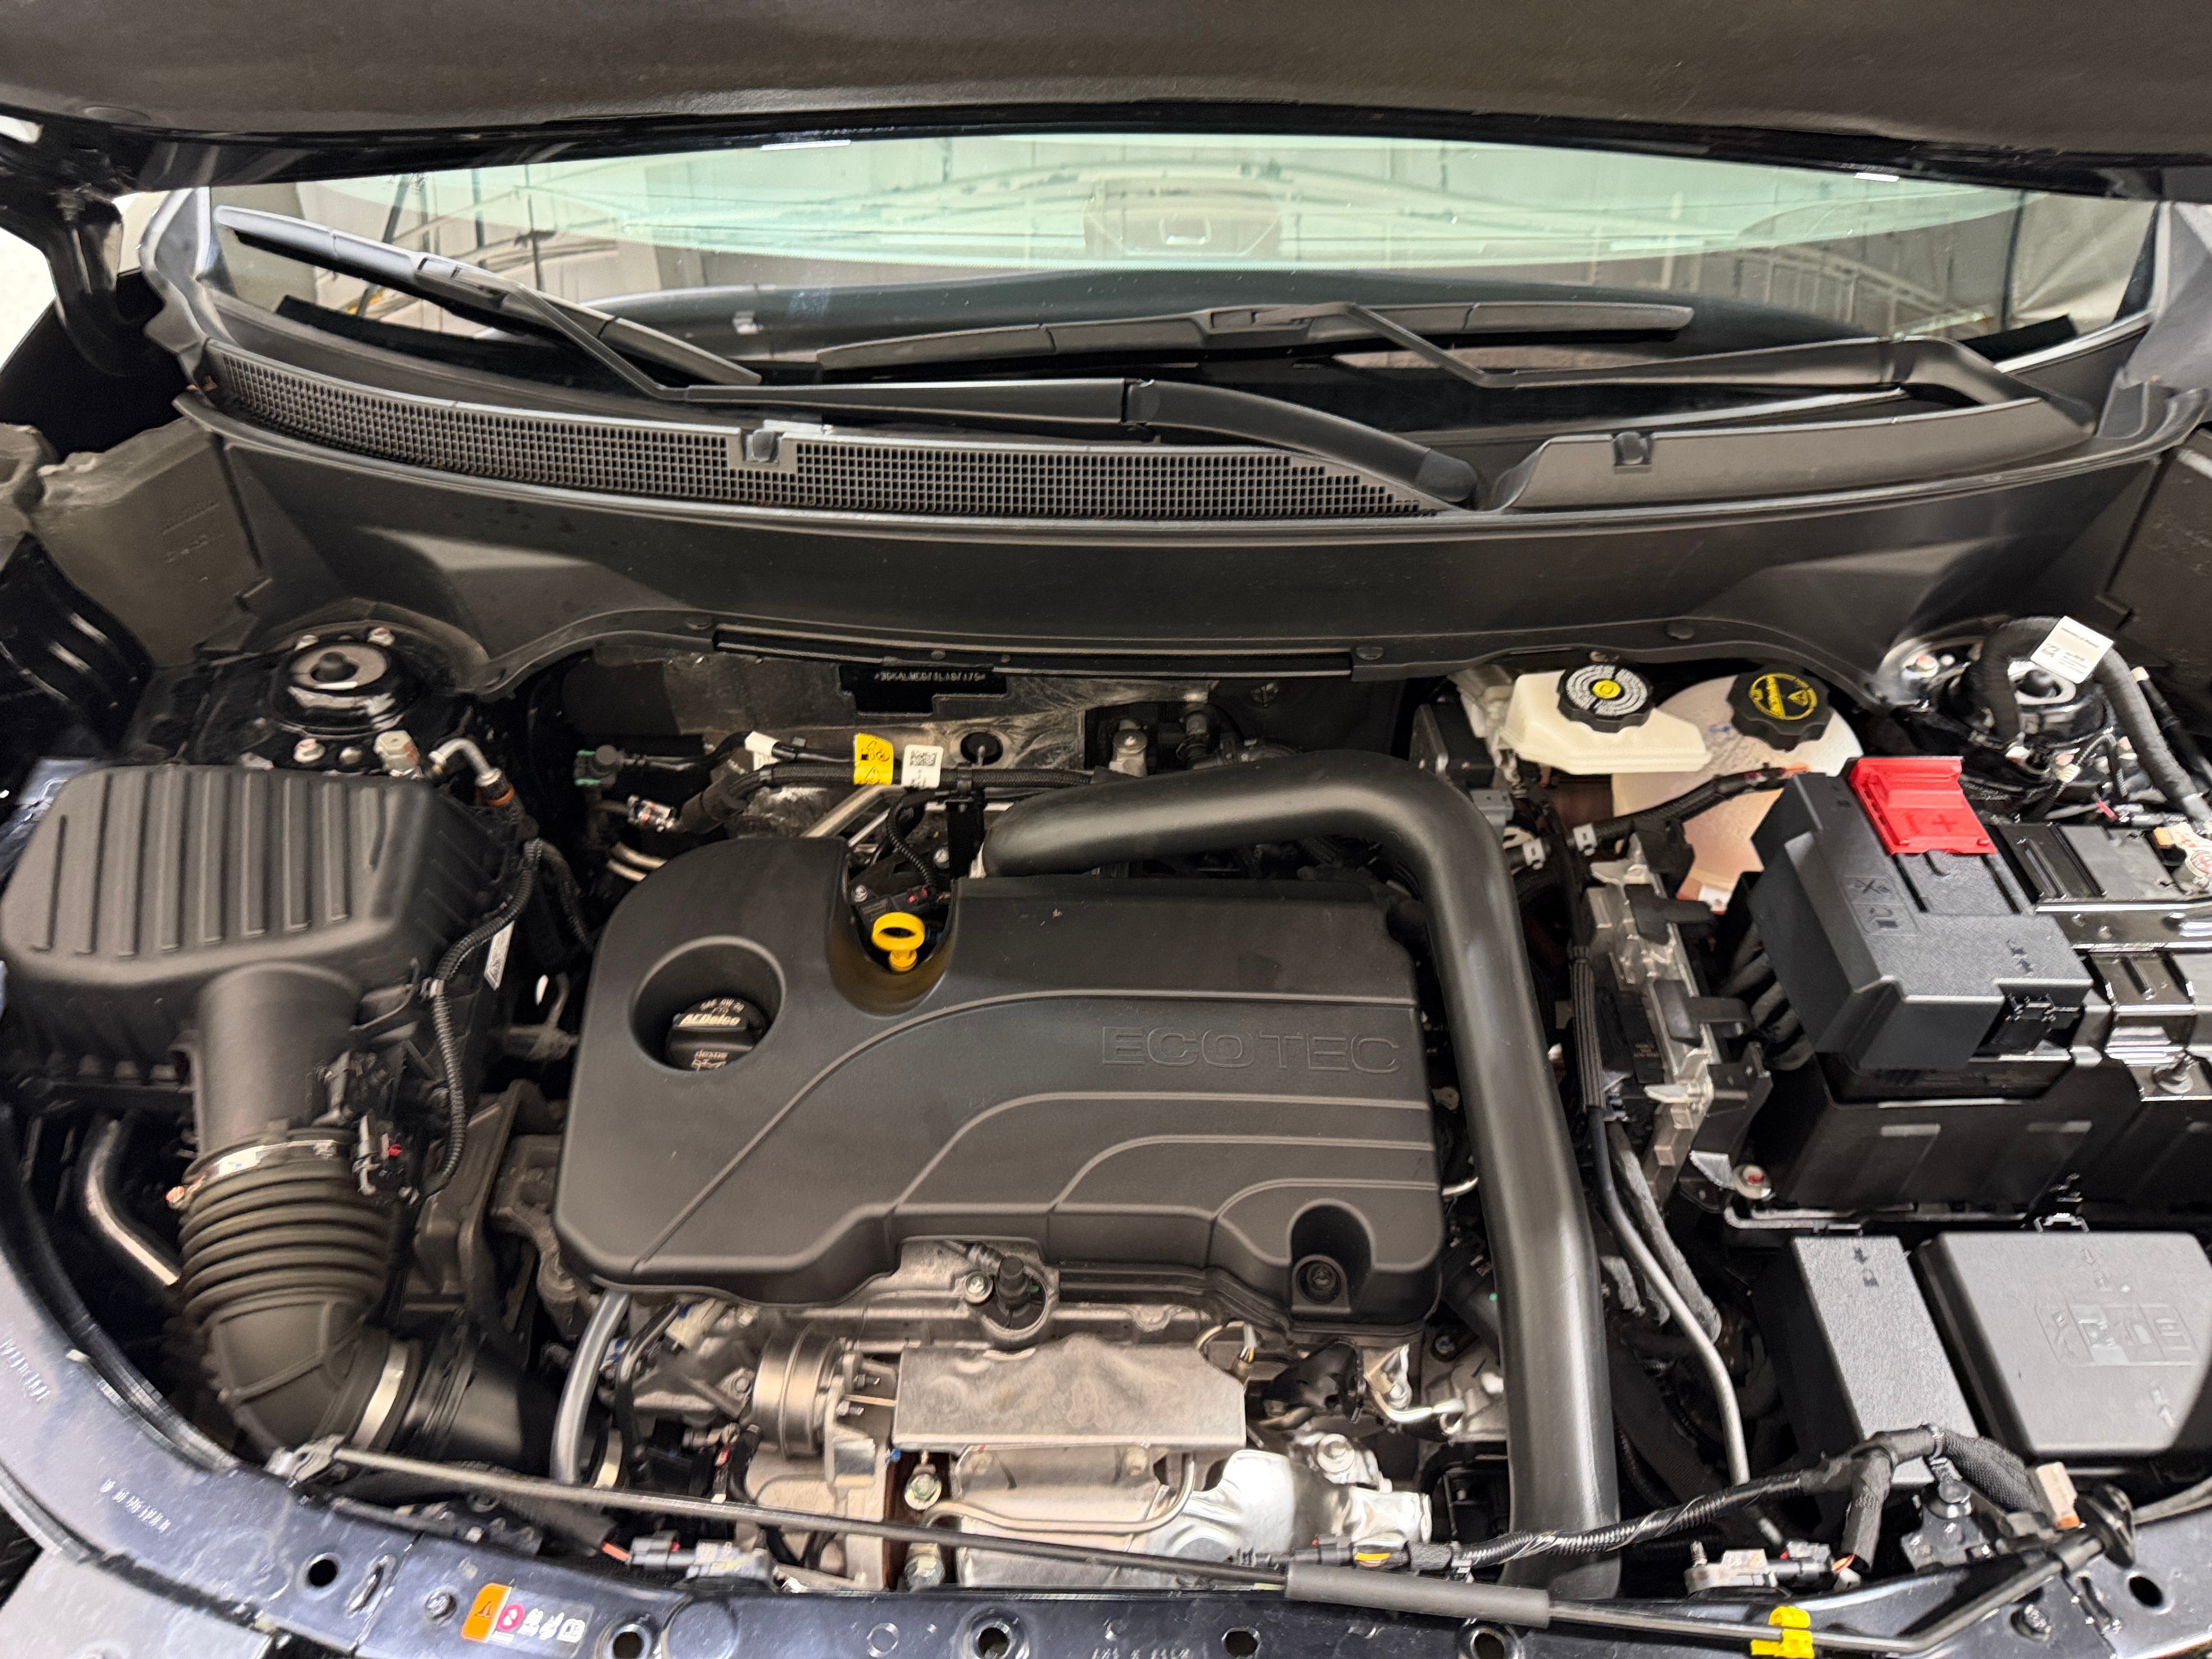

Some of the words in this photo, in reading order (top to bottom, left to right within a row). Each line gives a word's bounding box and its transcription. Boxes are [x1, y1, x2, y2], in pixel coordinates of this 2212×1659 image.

[701, 999, 718, 1011] SAE
[678, 1013, 741, 1027] ACDelco
[1102, 1026, 1400, 1074] ECOTEC
